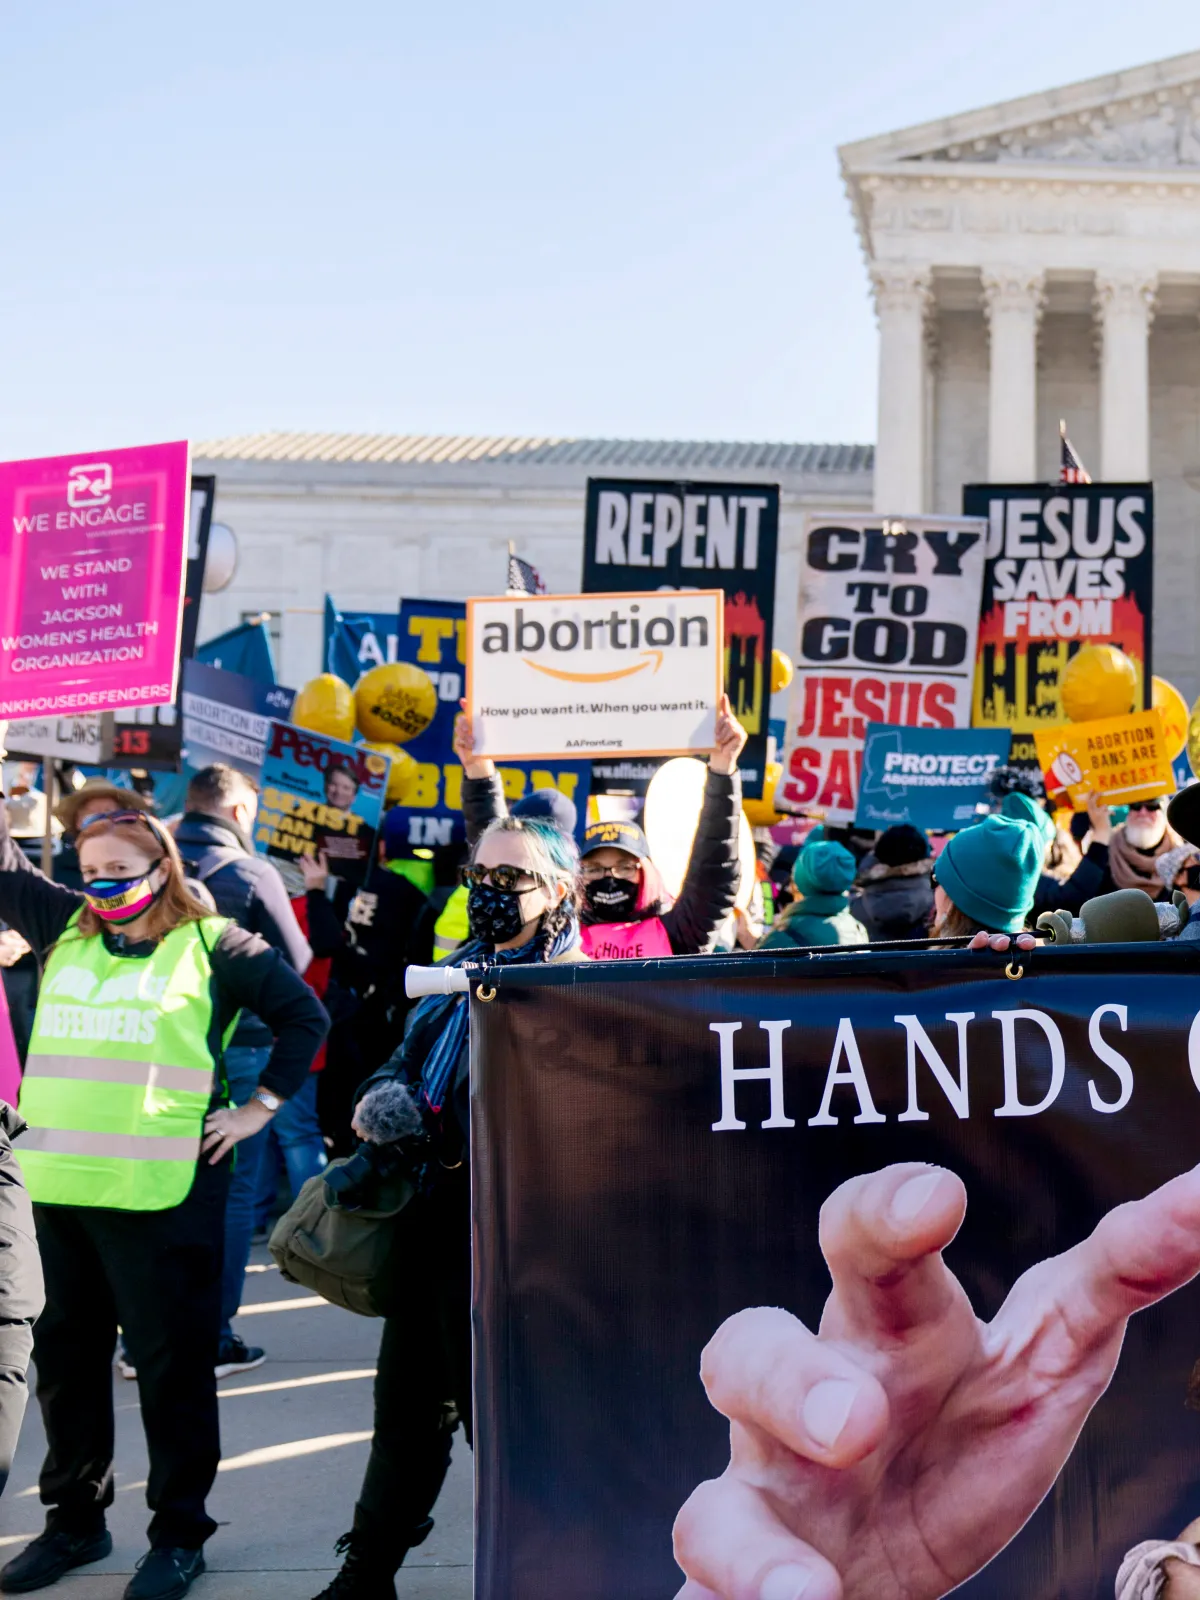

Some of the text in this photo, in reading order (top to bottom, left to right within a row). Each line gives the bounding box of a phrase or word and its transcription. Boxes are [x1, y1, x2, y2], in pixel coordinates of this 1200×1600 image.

[13, 503, 147, 534] WE ENGAGE
[595, 491, 768, 570] REPENT
[985, 497, 1146, 559] JESUS
[806, 527, 980, 576] CRY
[40, 558, 132, 580] WE STAND
[993, 558, 1126, 601] SAVES
[61, 584, 108, 600] WITH
[846, 582, 929, 616] TO
[41, 603, 123, 625] JACKSON
[482, 604, 708, 653] abortion
[1003, 599, 1113, 638] FROM
[1, 621, 158, 651] WOMEN'S HEALTH
[801, 617, 967, 667] GOD
[11, 646, 144, 672] ORGANIZATION
[481, 705, 509, 717] How
[512, 706, 537, 718] you
[541, 703, 573, 715] want
[590, 702, 628, 714] When
[632, 703, 658, 714] you
[660, 700, 693, 711] want
[695, 699, 709, 711] it.
[797, 676, 956, 739] JESUS
[1087, 726, 1154, 752] ABORTION
[883, 752, 999, 776] PROTECT
[1091, 744, 1158, 769] BANS ARE
[882, 773, 947, 786] ABORTION
[258, 810, 314, 839] MAN
[262, 788, 364, 836] SEXIST
[408, 816, 453, 846] IN
[38, 1003, 158, 1044] DEFENDERS
[709, 1004, 1135, 1132] HANDS
